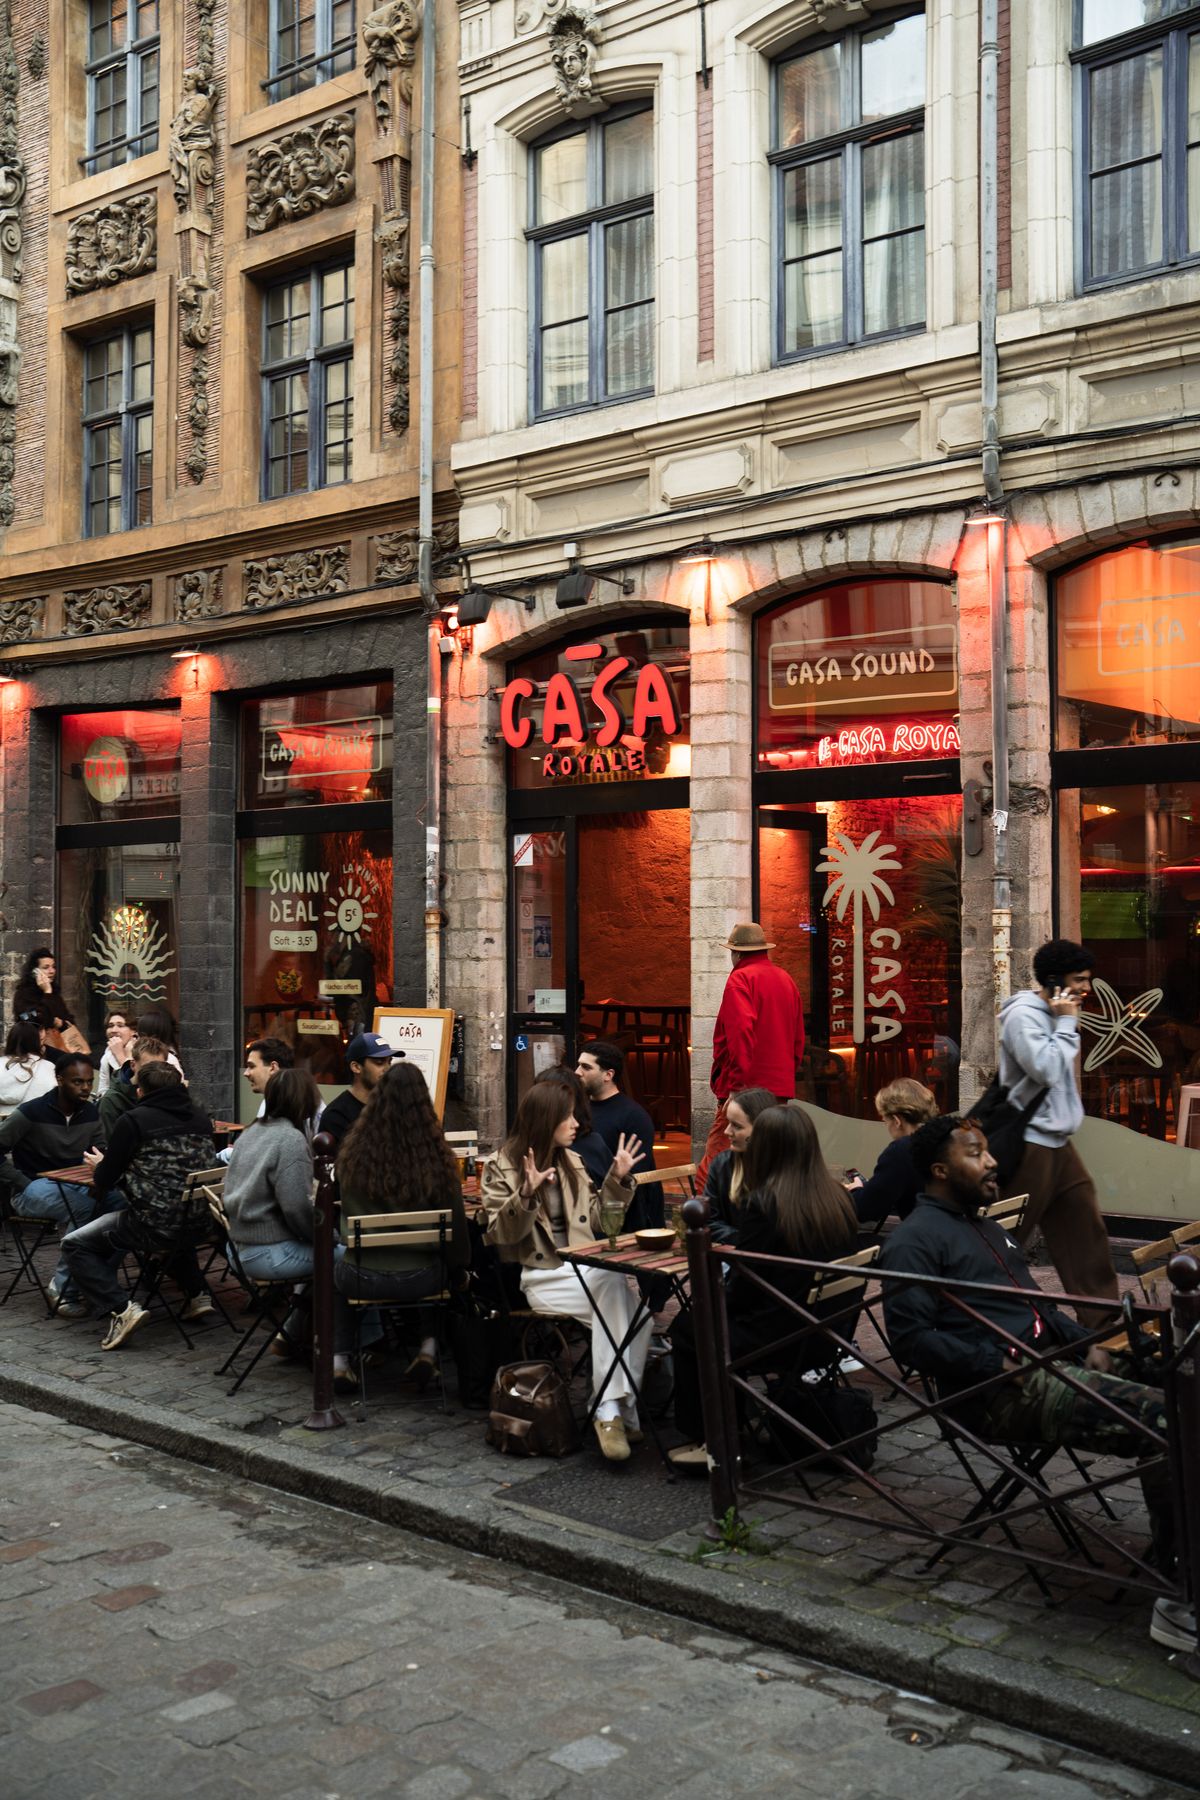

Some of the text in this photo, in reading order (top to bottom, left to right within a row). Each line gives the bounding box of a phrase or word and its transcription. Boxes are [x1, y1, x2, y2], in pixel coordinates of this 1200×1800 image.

[1117, 614, 1186, 648] CASA
[786, 648, 936, 686] CASA SOUND
[500, 648, 678, 748] CASA
[269, 740, 306, 762] CASA
[542, 750, 646, 777] ROYALE
[85, 754, 127, 780] CASA
[269, 869, 330, 896] SUNNY
[342, 863, 380, 895] LA PINTE
[270, 899, 319, 923] DEAL
[344, 908, 358, 922] 5€
[274, 936, 291, 946] Soft
[831, 937, 847, 1032] ROYALE
[868, 927, 906, 1043] CASA
[399, 1024, 422, 1038] CASA
